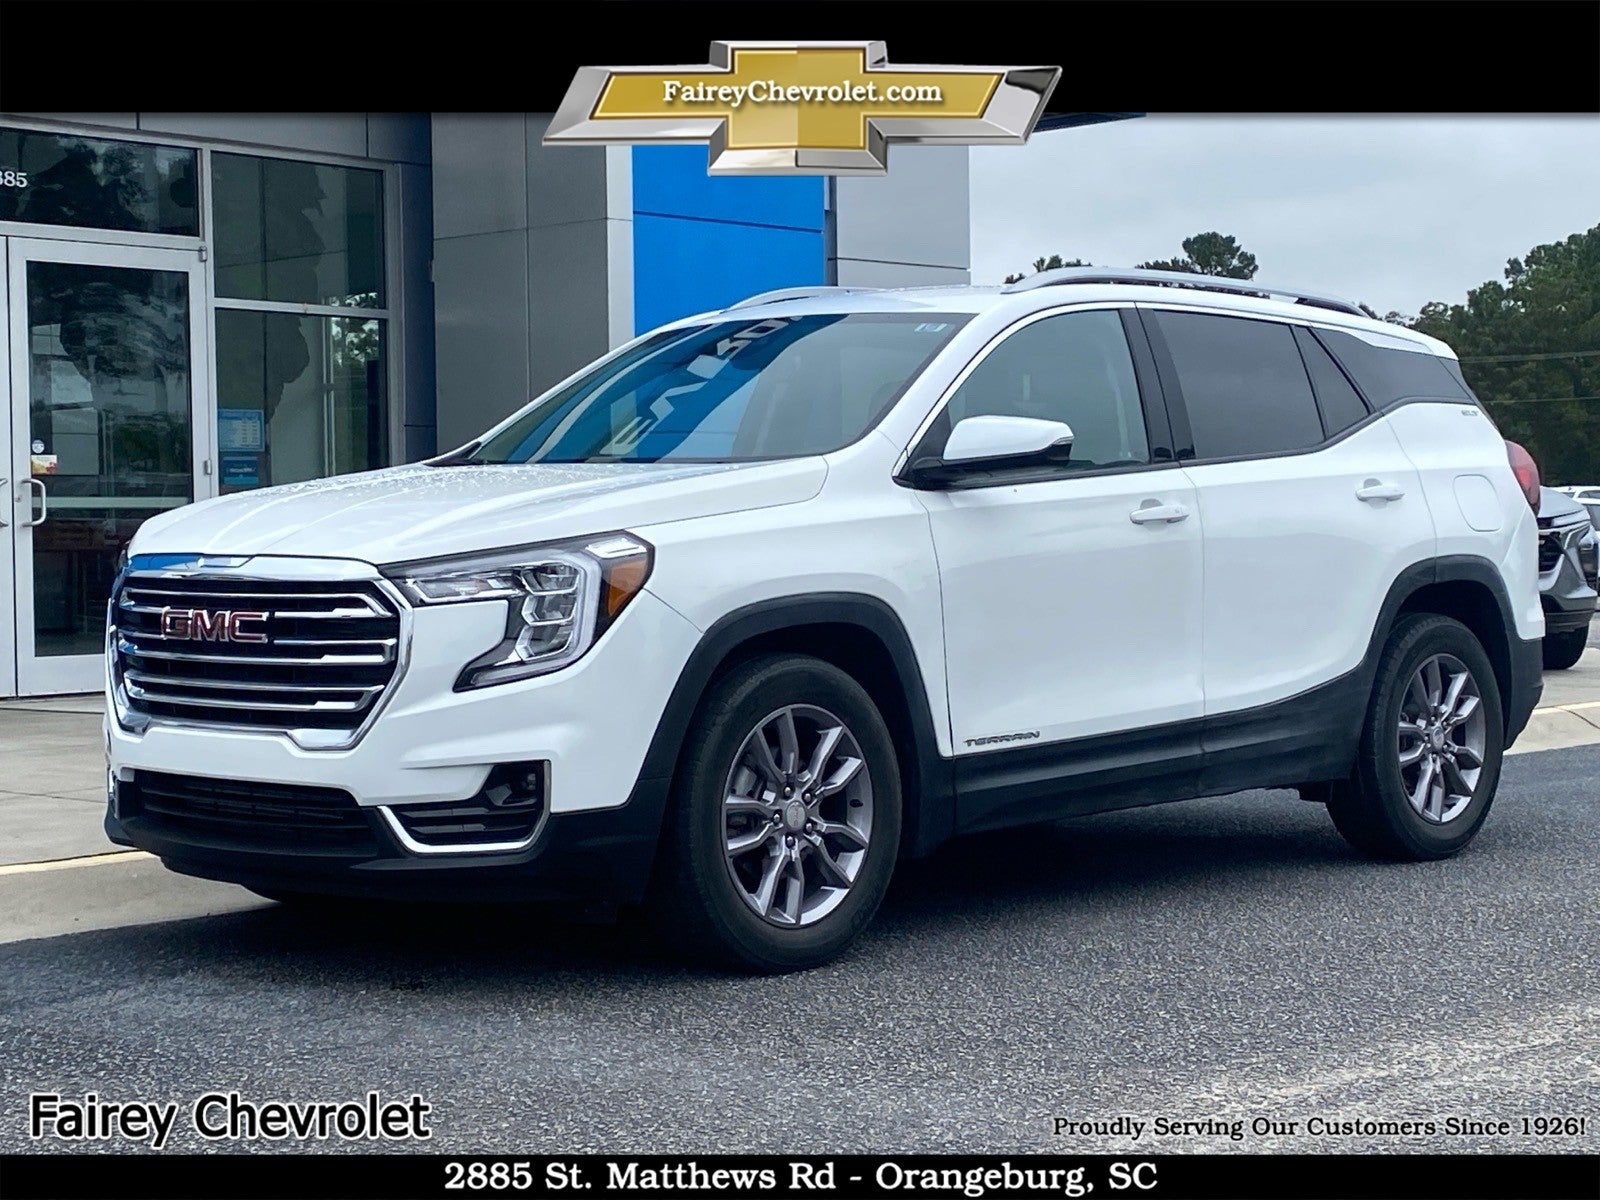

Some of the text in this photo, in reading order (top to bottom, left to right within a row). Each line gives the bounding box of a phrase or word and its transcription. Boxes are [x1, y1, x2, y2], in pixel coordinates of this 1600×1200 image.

[0, 170, 28, 188] 85
[161, 606, 270, 643] GMC
[963, 730, 1040, 747] TERRAIN
